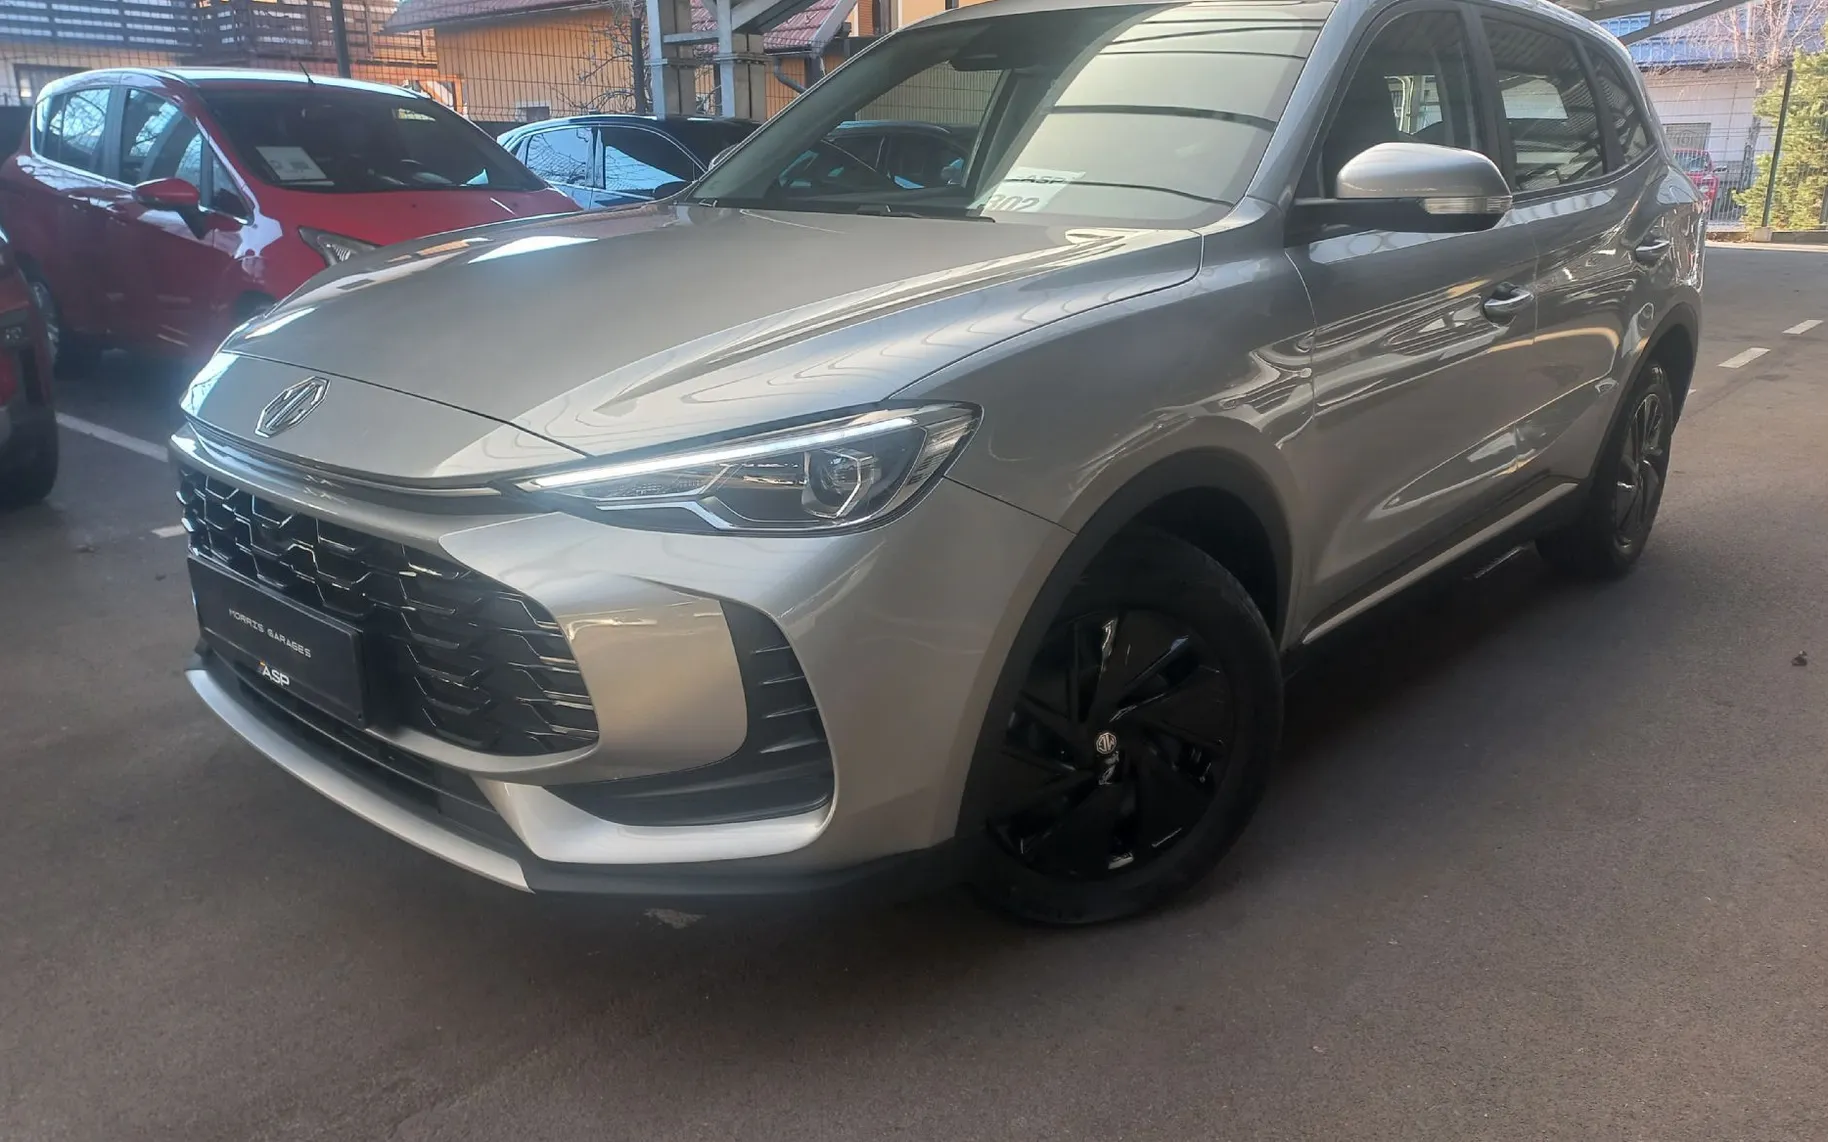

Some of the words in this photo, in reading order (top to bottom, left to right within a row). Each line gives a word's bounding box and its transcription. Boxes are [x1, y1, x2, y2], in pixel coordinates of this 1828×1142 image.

[228, 608, 264, 633] MORRIS
[267, 628, 312, 658] GARAGES
[262, 665, 290, 686] ASP
